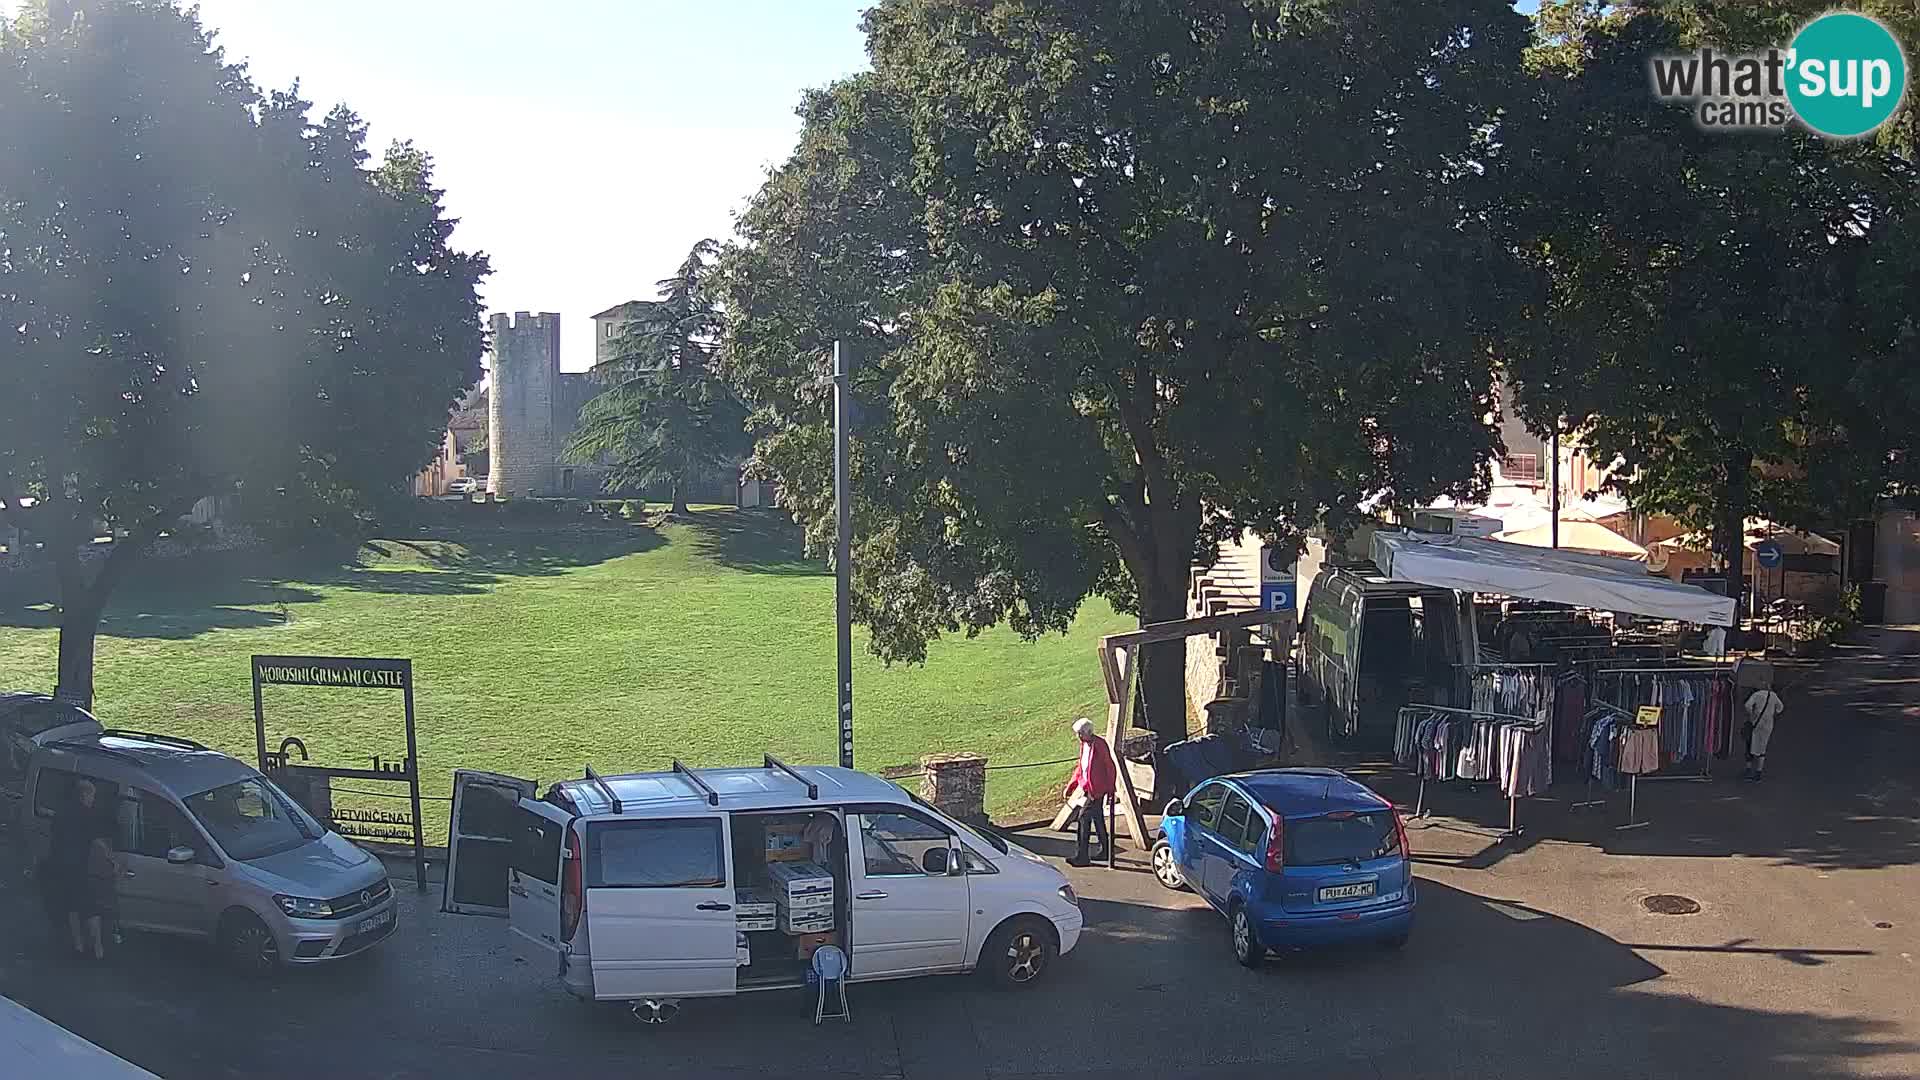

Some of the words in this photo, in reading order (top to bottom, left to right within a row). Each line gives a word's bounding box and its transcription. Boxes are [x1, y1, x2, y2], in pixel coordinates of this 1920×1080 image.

[1270, 591, 1287, 611] P
[259, 665, 309, 683] MOROSINI
[310, 667, 361, 686] GRIMANI
[362, 669, 404, 686] CASTLE
